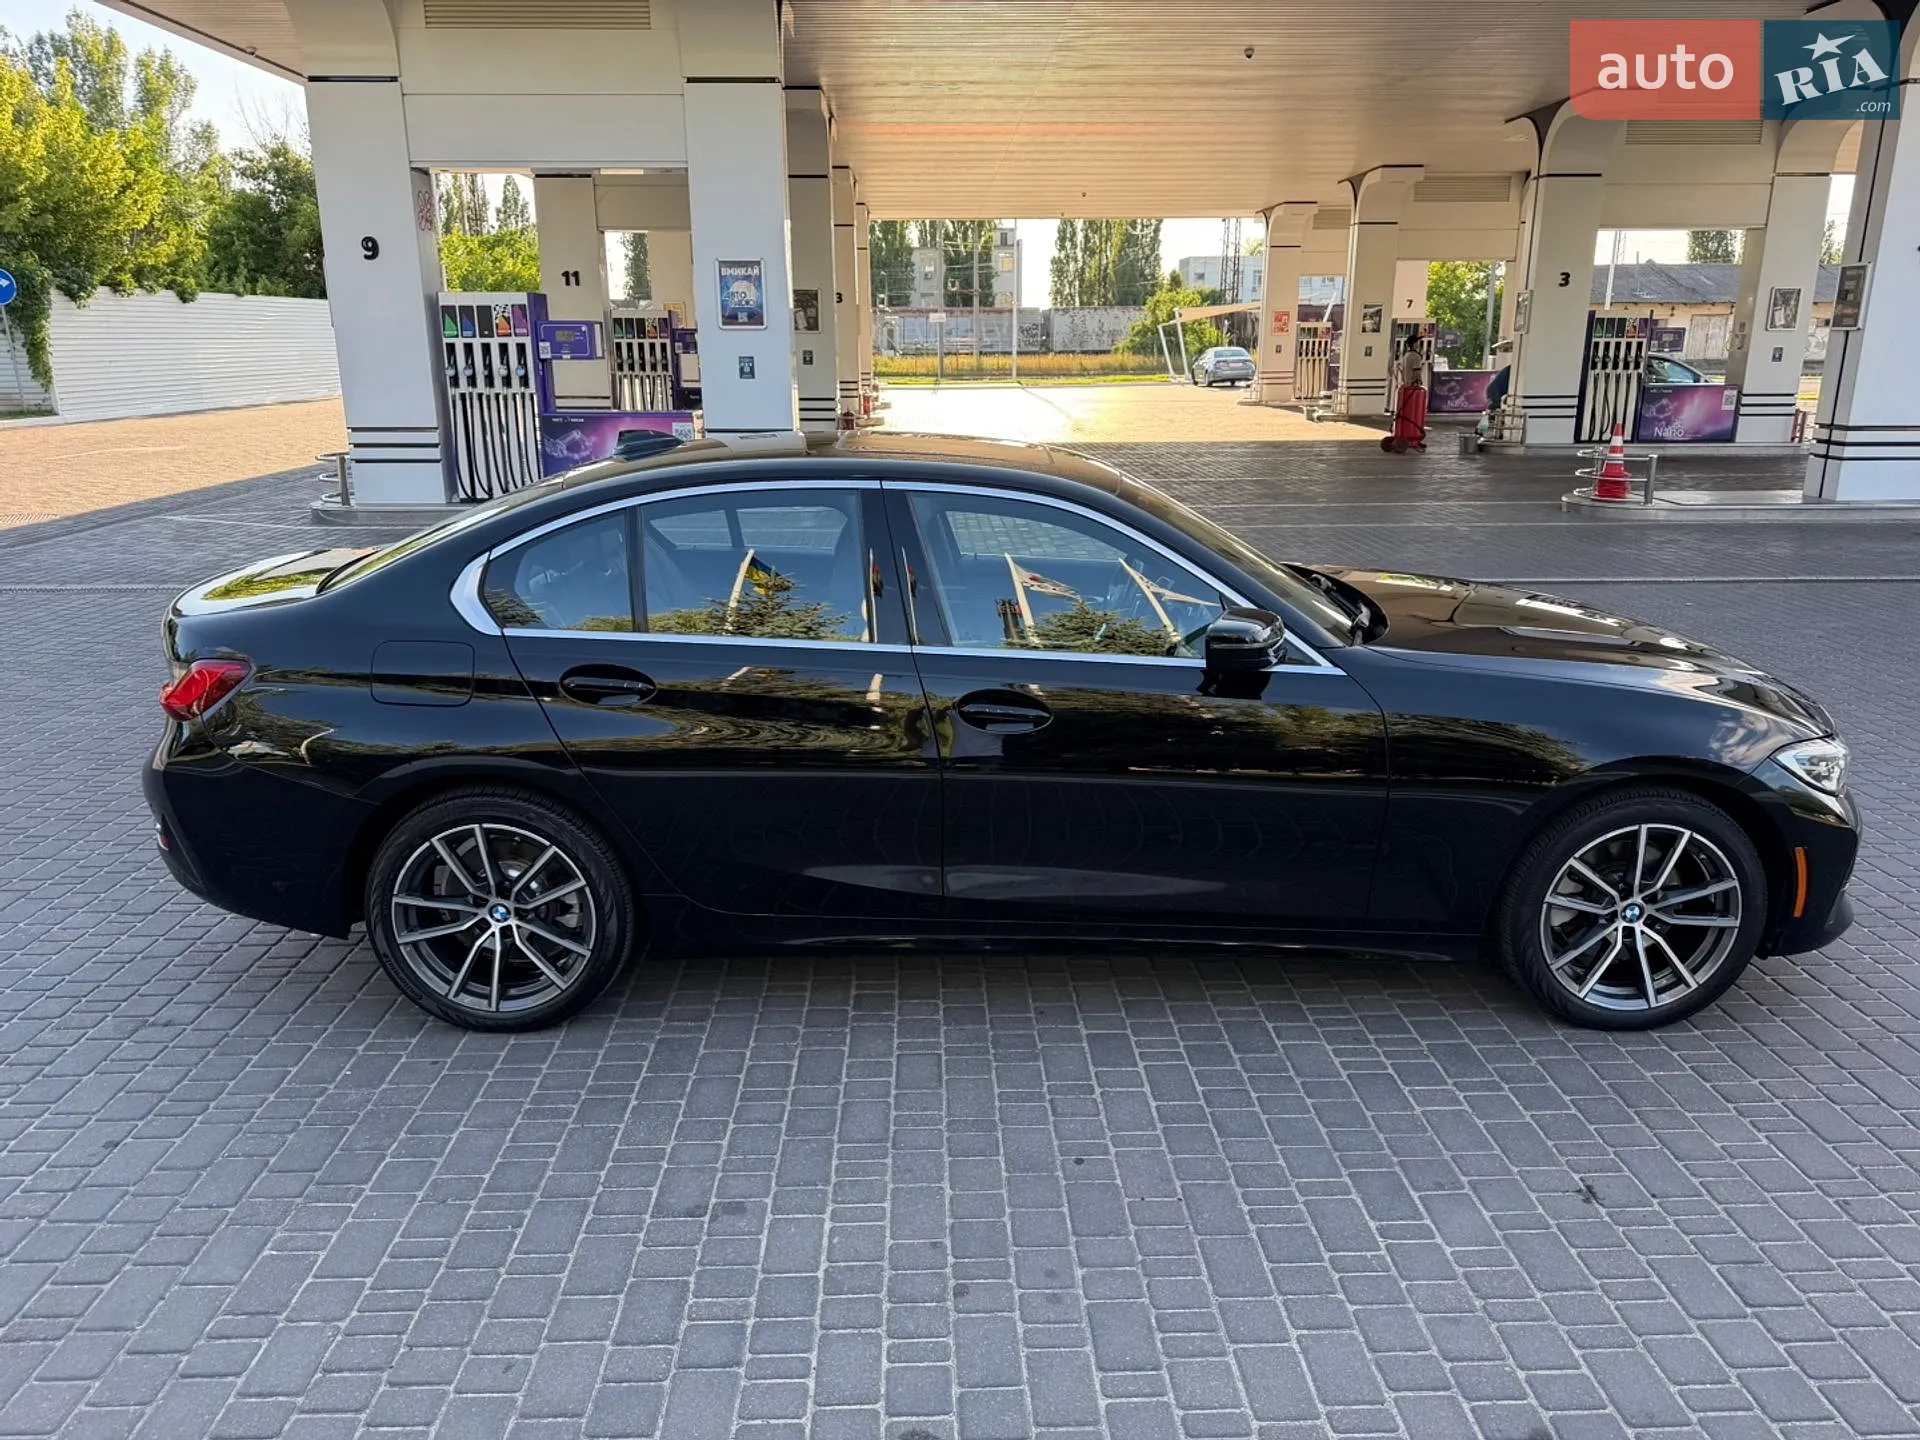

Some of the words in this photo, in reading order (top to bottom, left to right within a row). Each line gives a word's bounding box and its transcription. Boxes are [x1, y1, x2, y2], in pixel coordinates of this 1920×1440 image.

[361, 236, 380, 260] 9
[721, 265, 760, 276] ВМИКАЙ
[561, 270, 580, 286] 11
[1558, 271, 1571, 287] 3
[1406, 299, 1414, 309] 7
[1653, 426, 1685, 438] Nano
